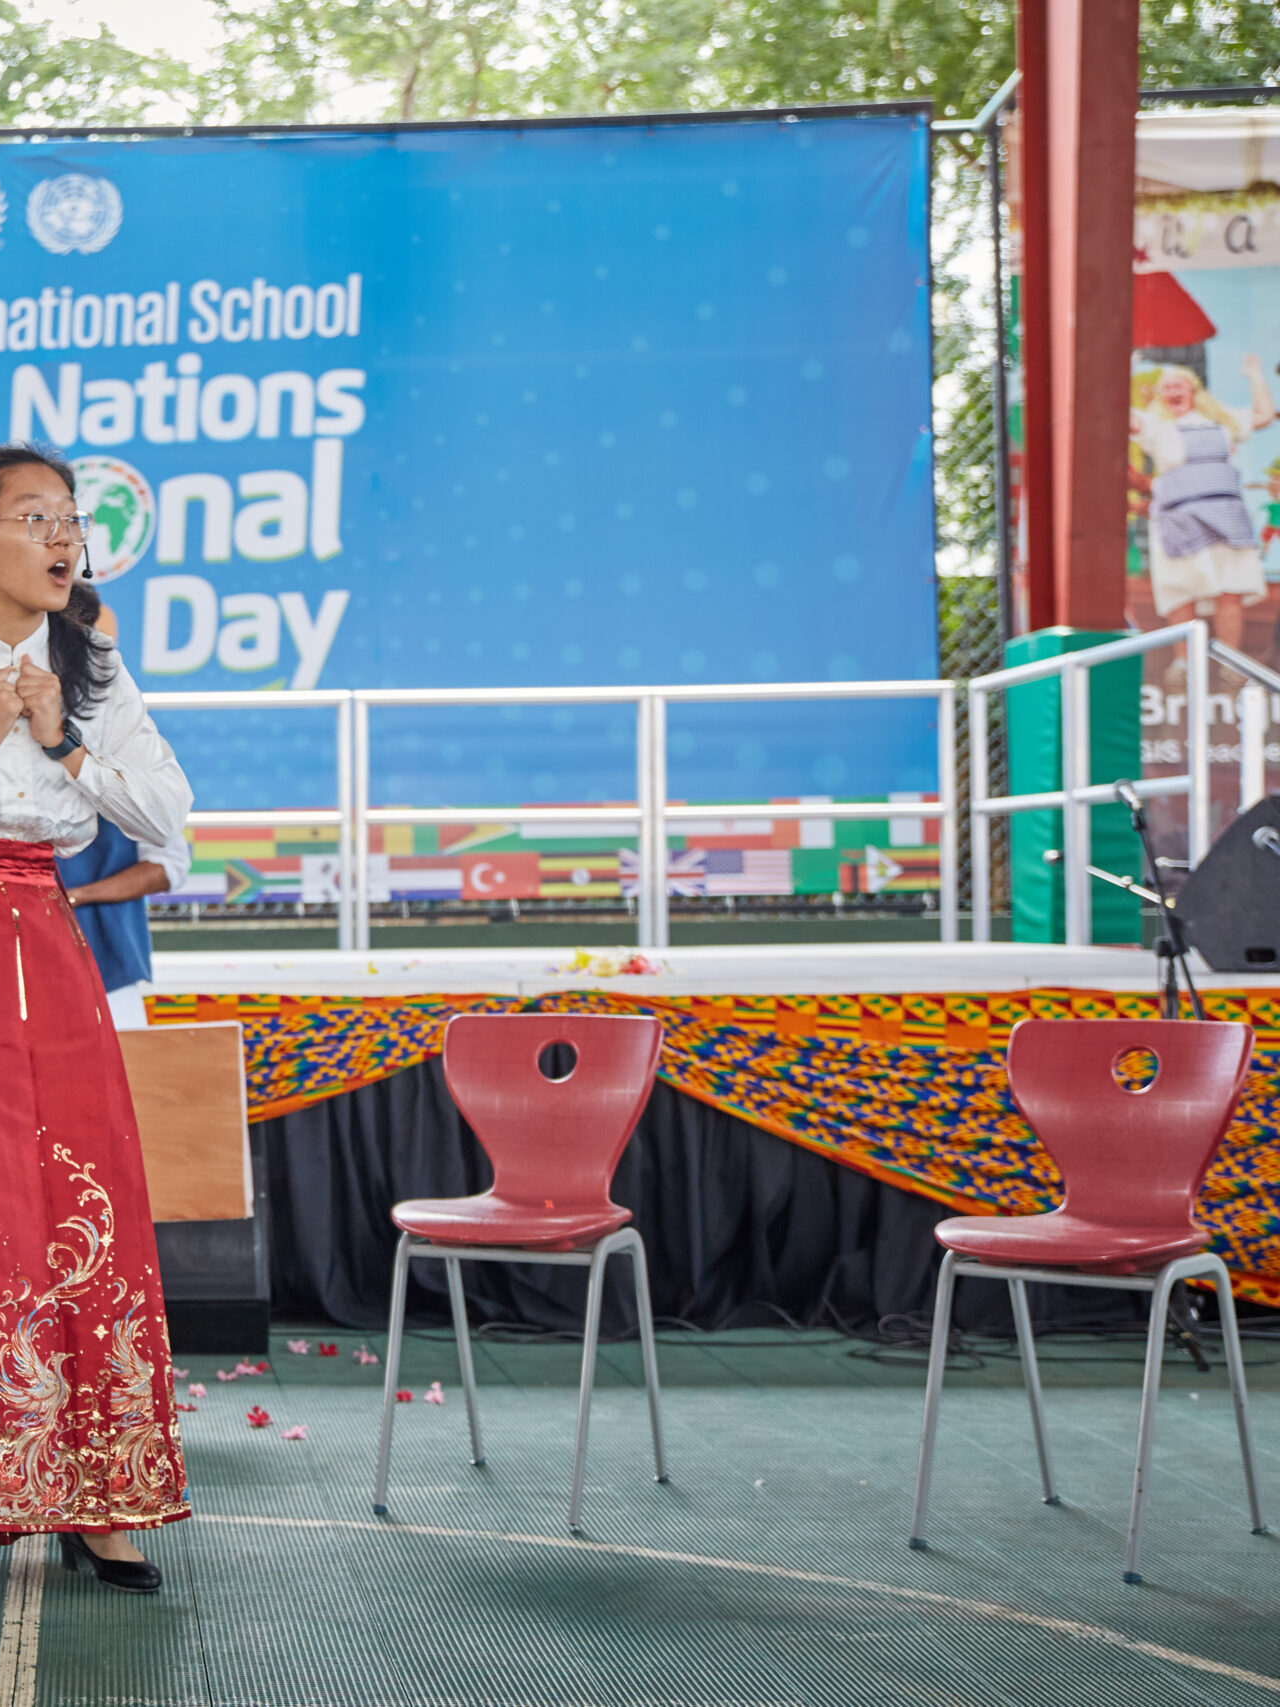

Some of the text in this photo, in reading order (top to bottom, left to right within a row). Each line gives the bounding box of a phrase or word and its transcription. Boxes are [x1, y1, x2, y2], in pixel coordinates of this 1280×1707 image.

[187, 272, 362, 344] School
[9, 352, 367, 449] Nations
[140, 573, 351, 691] Day
